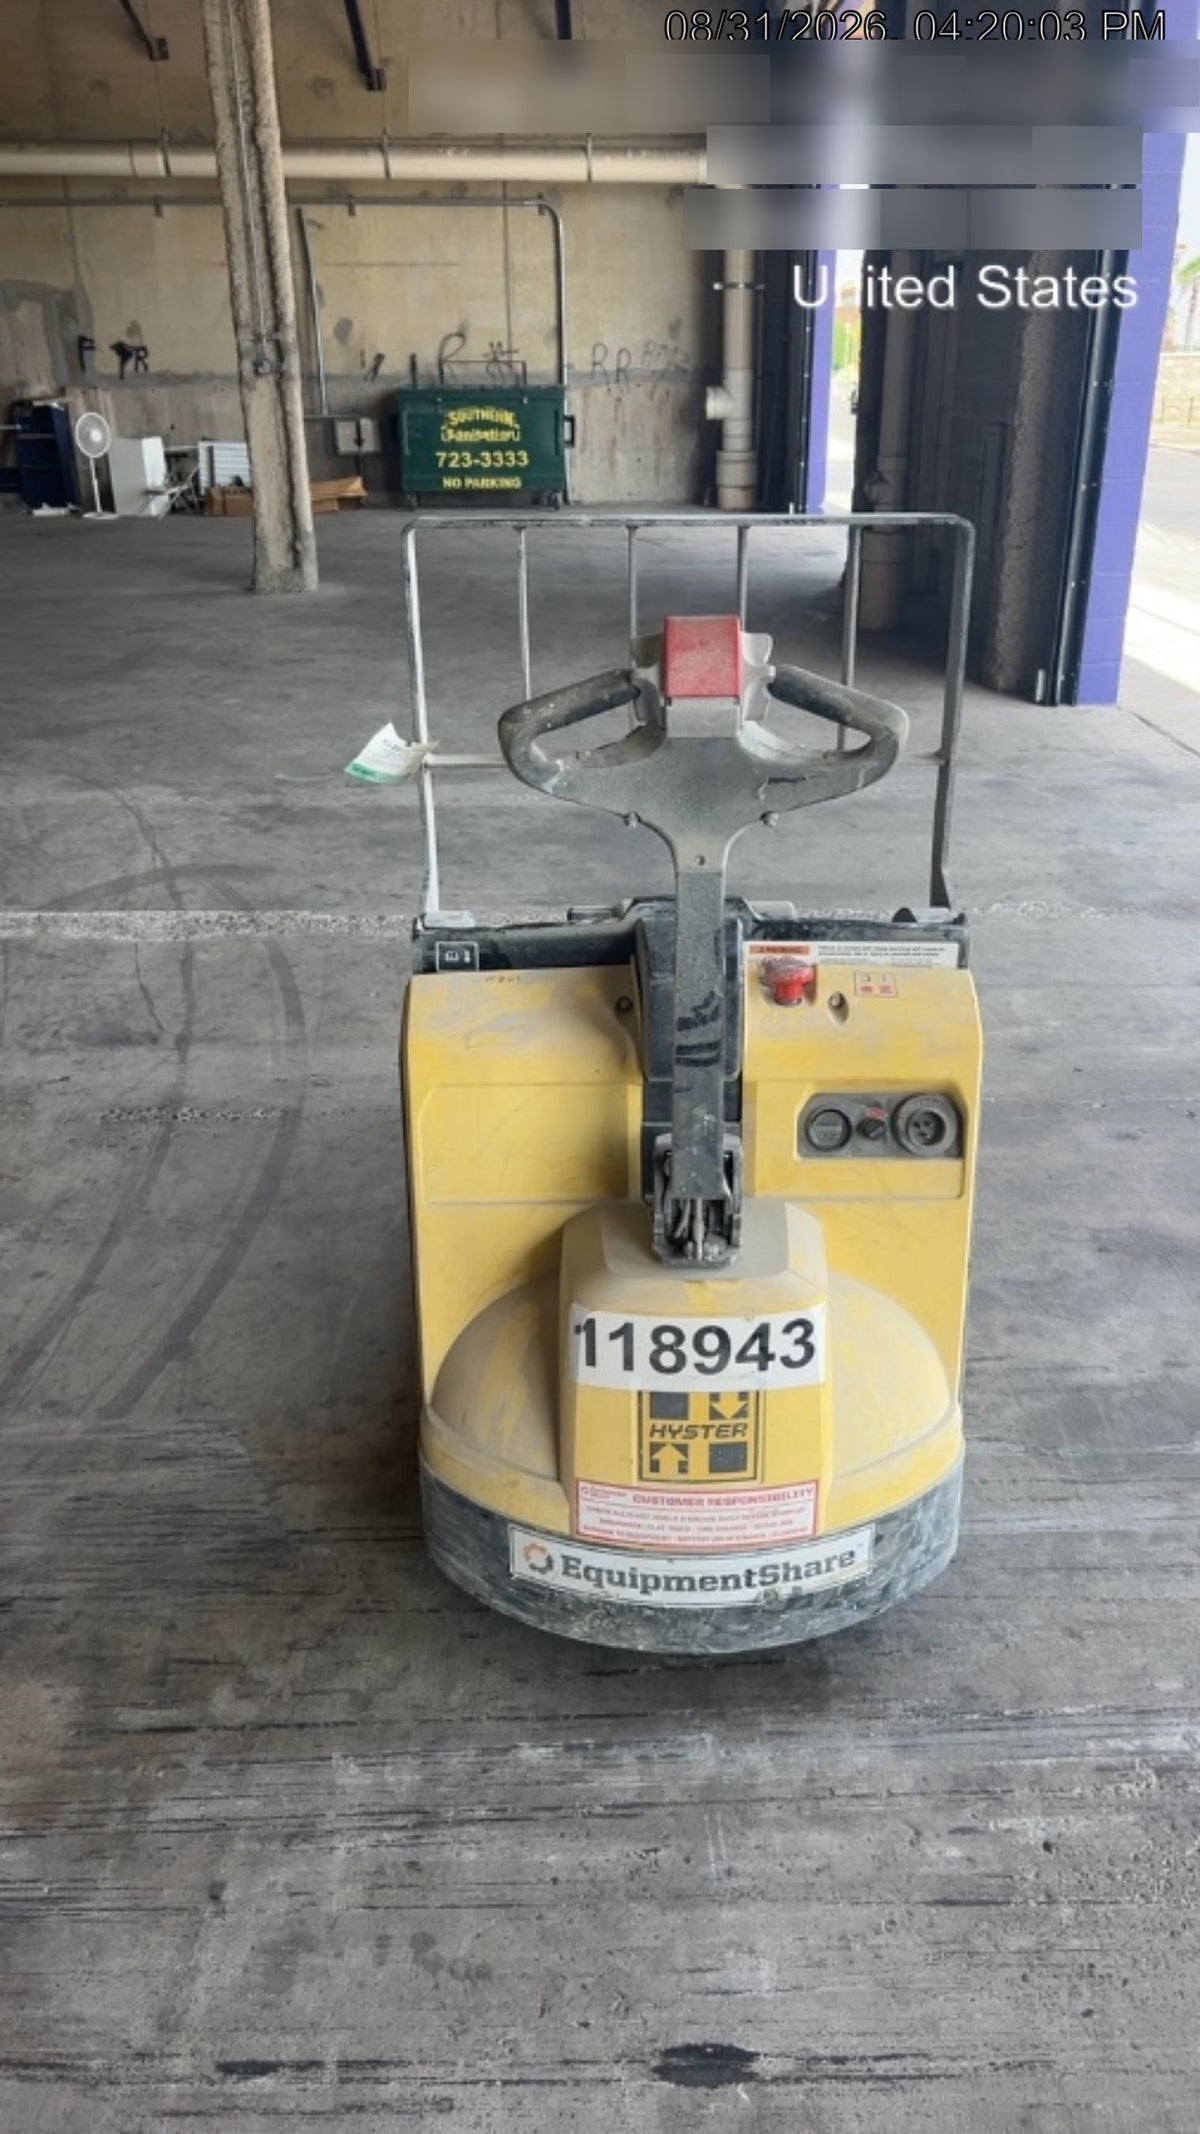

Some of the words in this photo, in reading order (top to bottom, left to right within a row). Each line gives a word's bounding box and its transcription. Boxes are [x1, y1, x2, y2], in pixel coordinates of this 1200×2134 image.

[435, 451, 529, 468] 723-3333
[442, 476, 462, 490] NO
[464, 475, 522, 490] PARKING
[574, 1317, 815, 1376] 118943
[649, 1421, 748, 1440] HYSTER
[632, 1493, 704, 1508] CUSTOMER
[706, 1486, 814, 1507] RESPONSIBILITY
[561, 1549, 856, 1595] EquipmentShare
